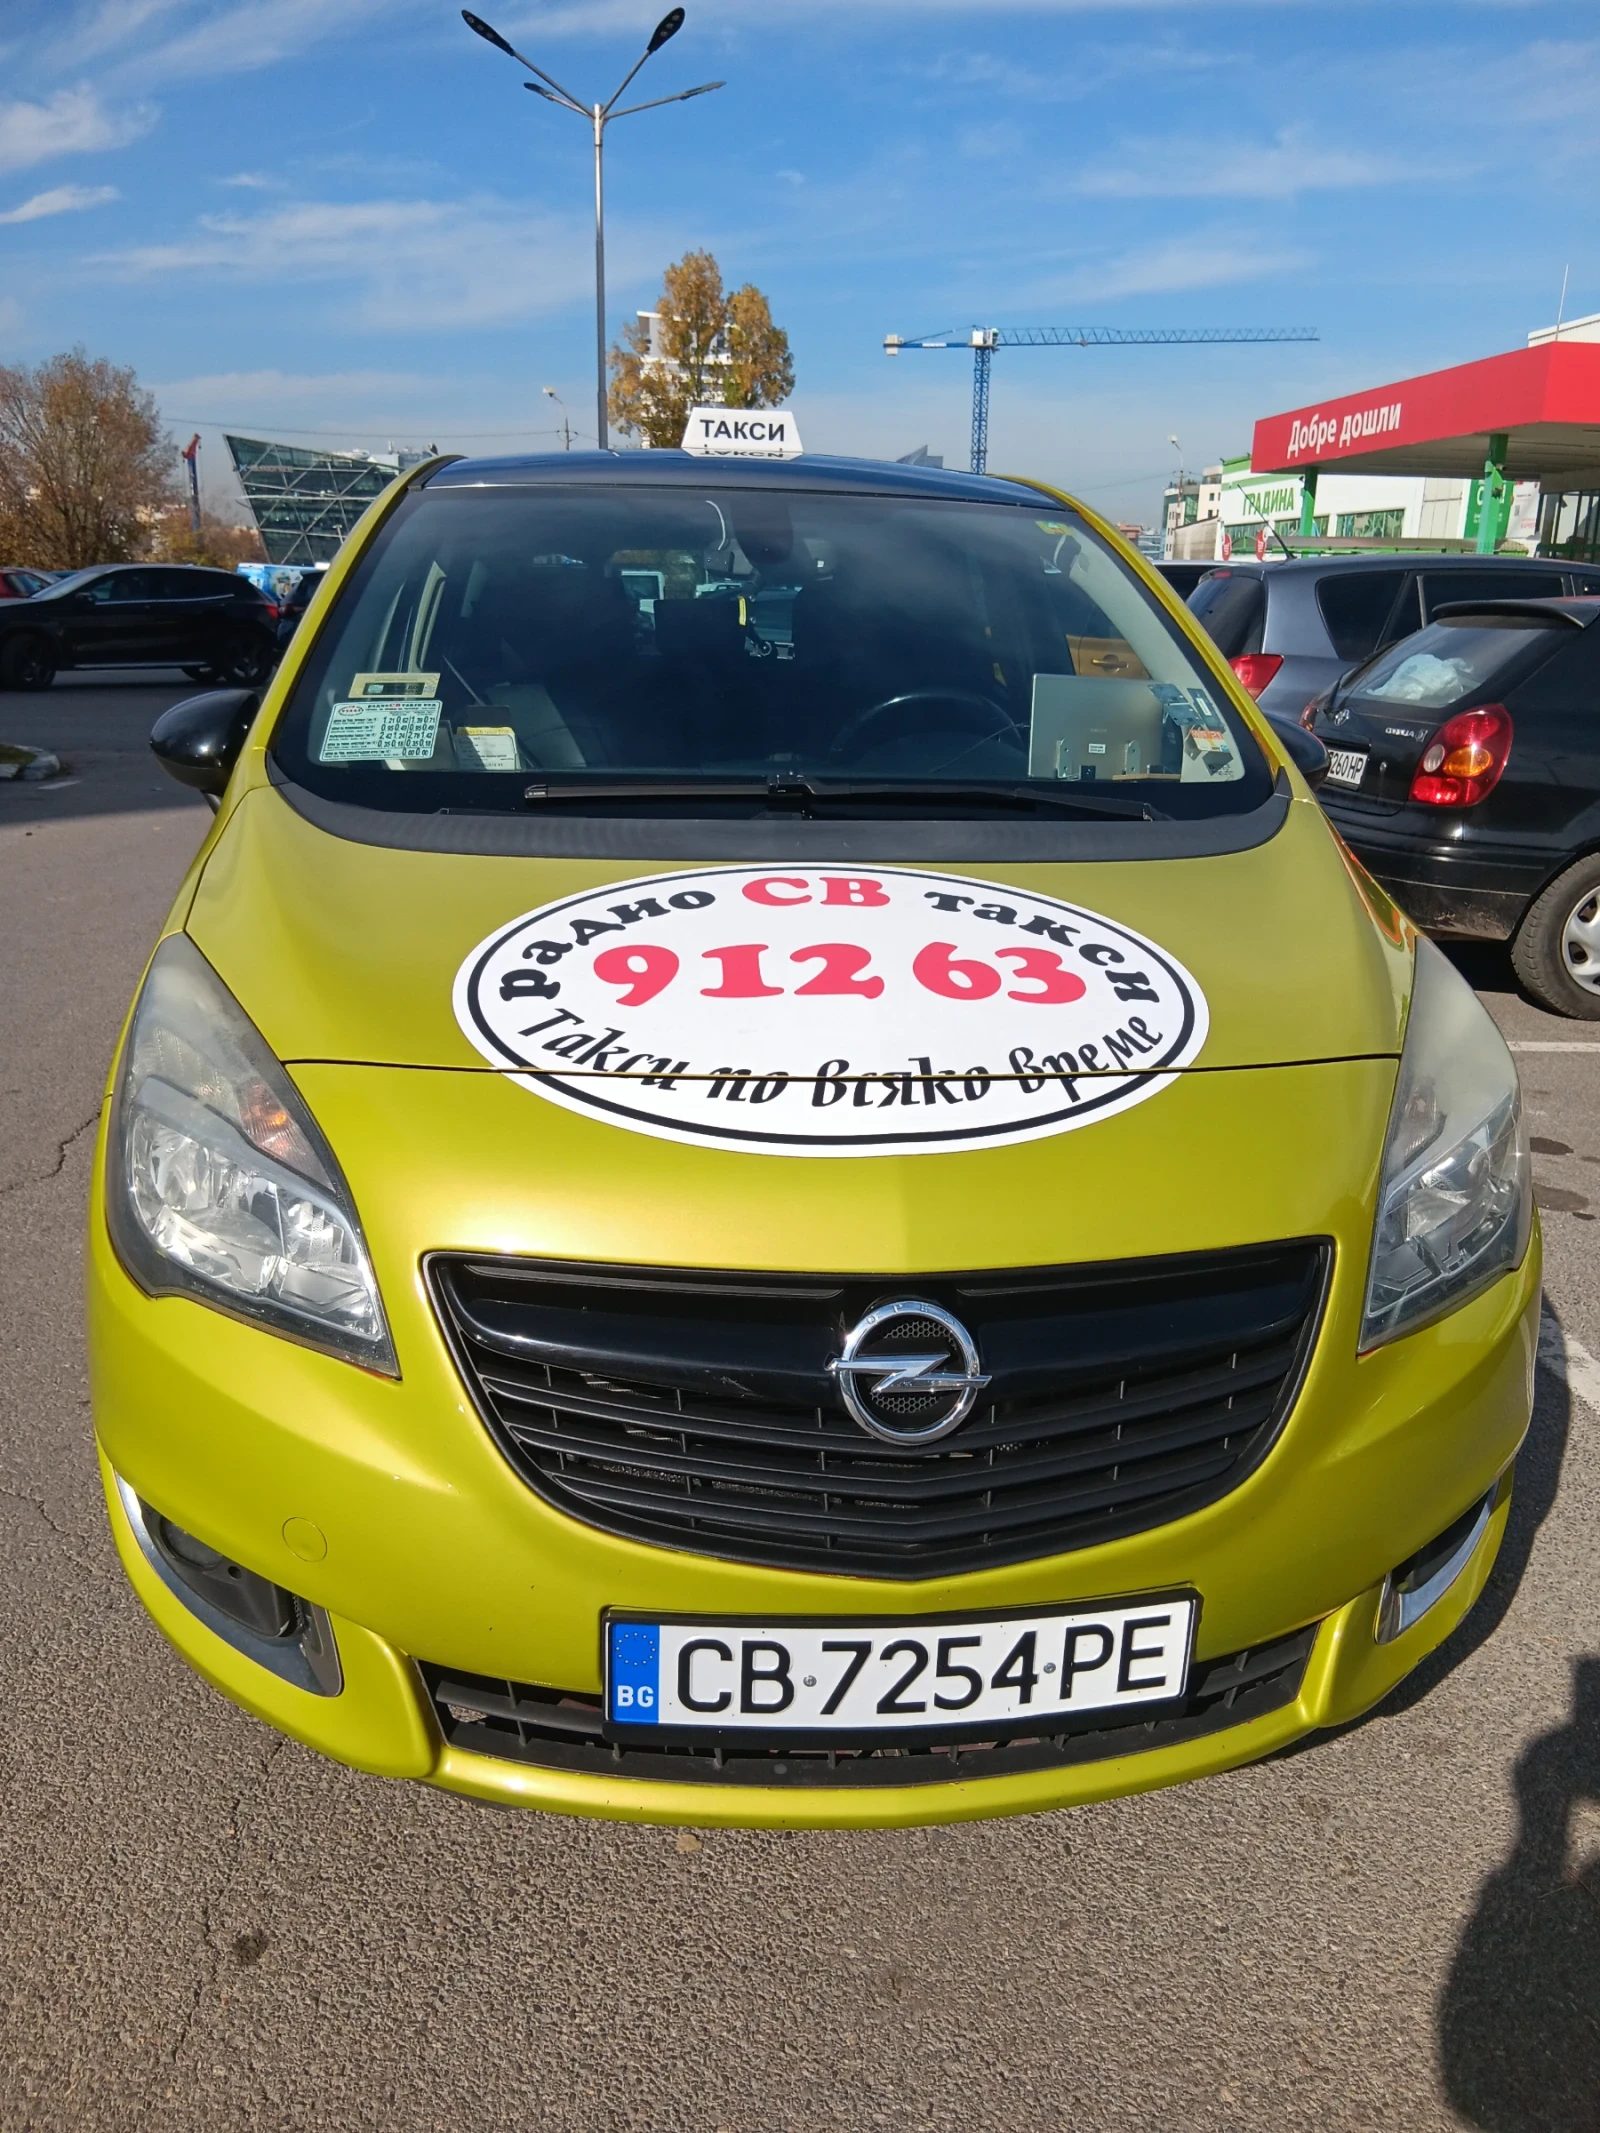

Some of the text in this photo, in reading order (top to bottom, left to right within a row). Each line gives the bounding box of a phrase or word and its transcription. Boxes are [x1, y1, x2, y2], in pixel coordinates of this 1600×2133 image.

[699, 419, 785, 442] ТАКСИ
[1286, 403, 1402, 459] Добре дошли
[1242, 487, 1294, 516] ГРАДИНА
[498, 890, 716, 1002] радио
[923, 890, 1161, 1004] такси
[516, 1007, 1164, 1109] Такси по всяко време
[616, 1685, 655, 1709] BG
